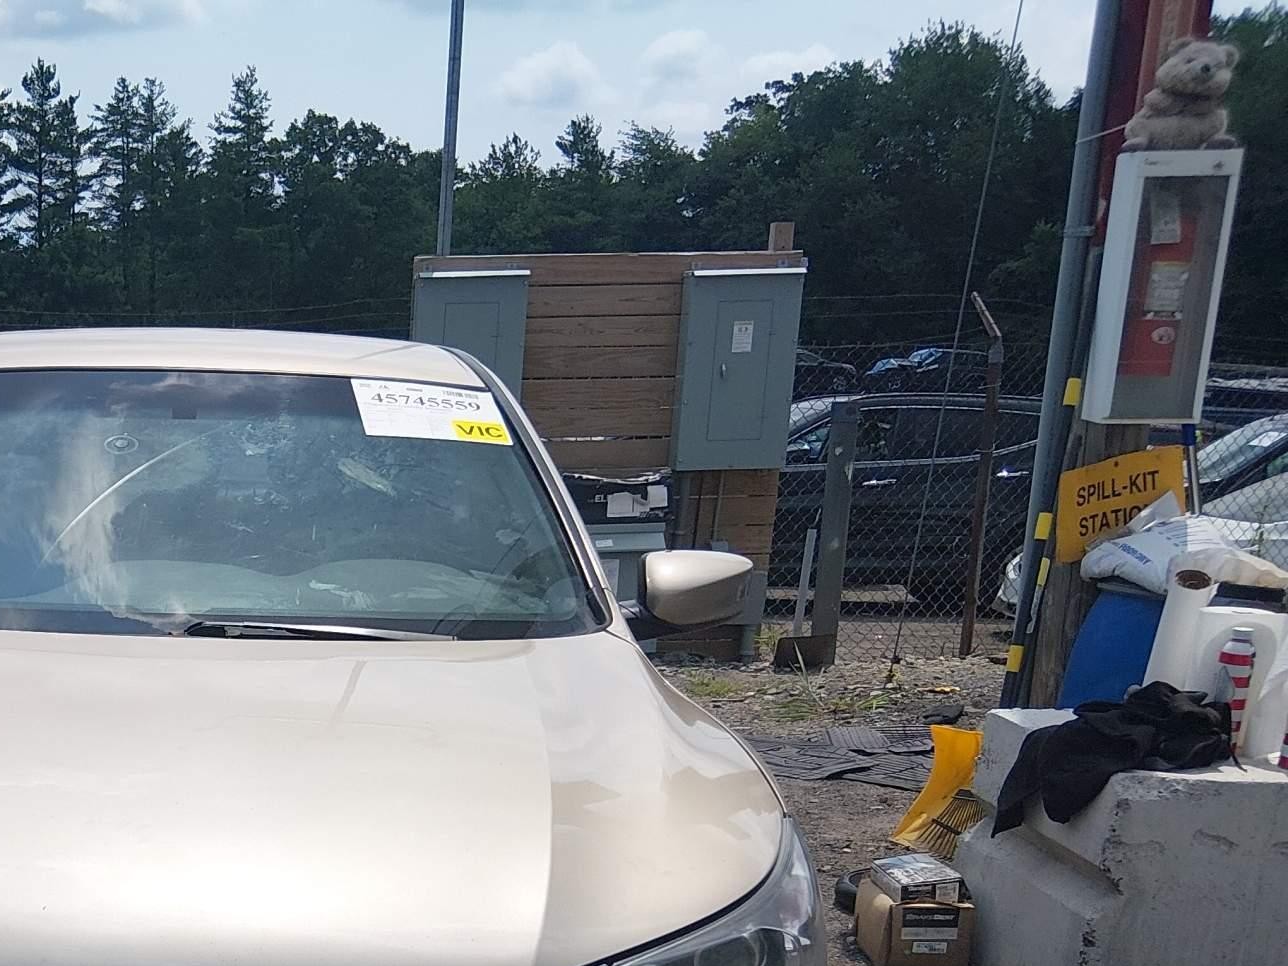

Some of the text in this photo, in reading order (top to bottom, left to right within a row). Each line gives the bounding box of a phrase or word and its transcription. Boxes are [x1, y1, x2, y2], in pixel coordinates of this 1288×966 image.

[371, 392, 481, 412] 45745559
[456, 423, 503, 438] VIC
[1076, 470, 1159, 507] SPILL-KIT
[1079, 504, 1149, 537] STATIO
